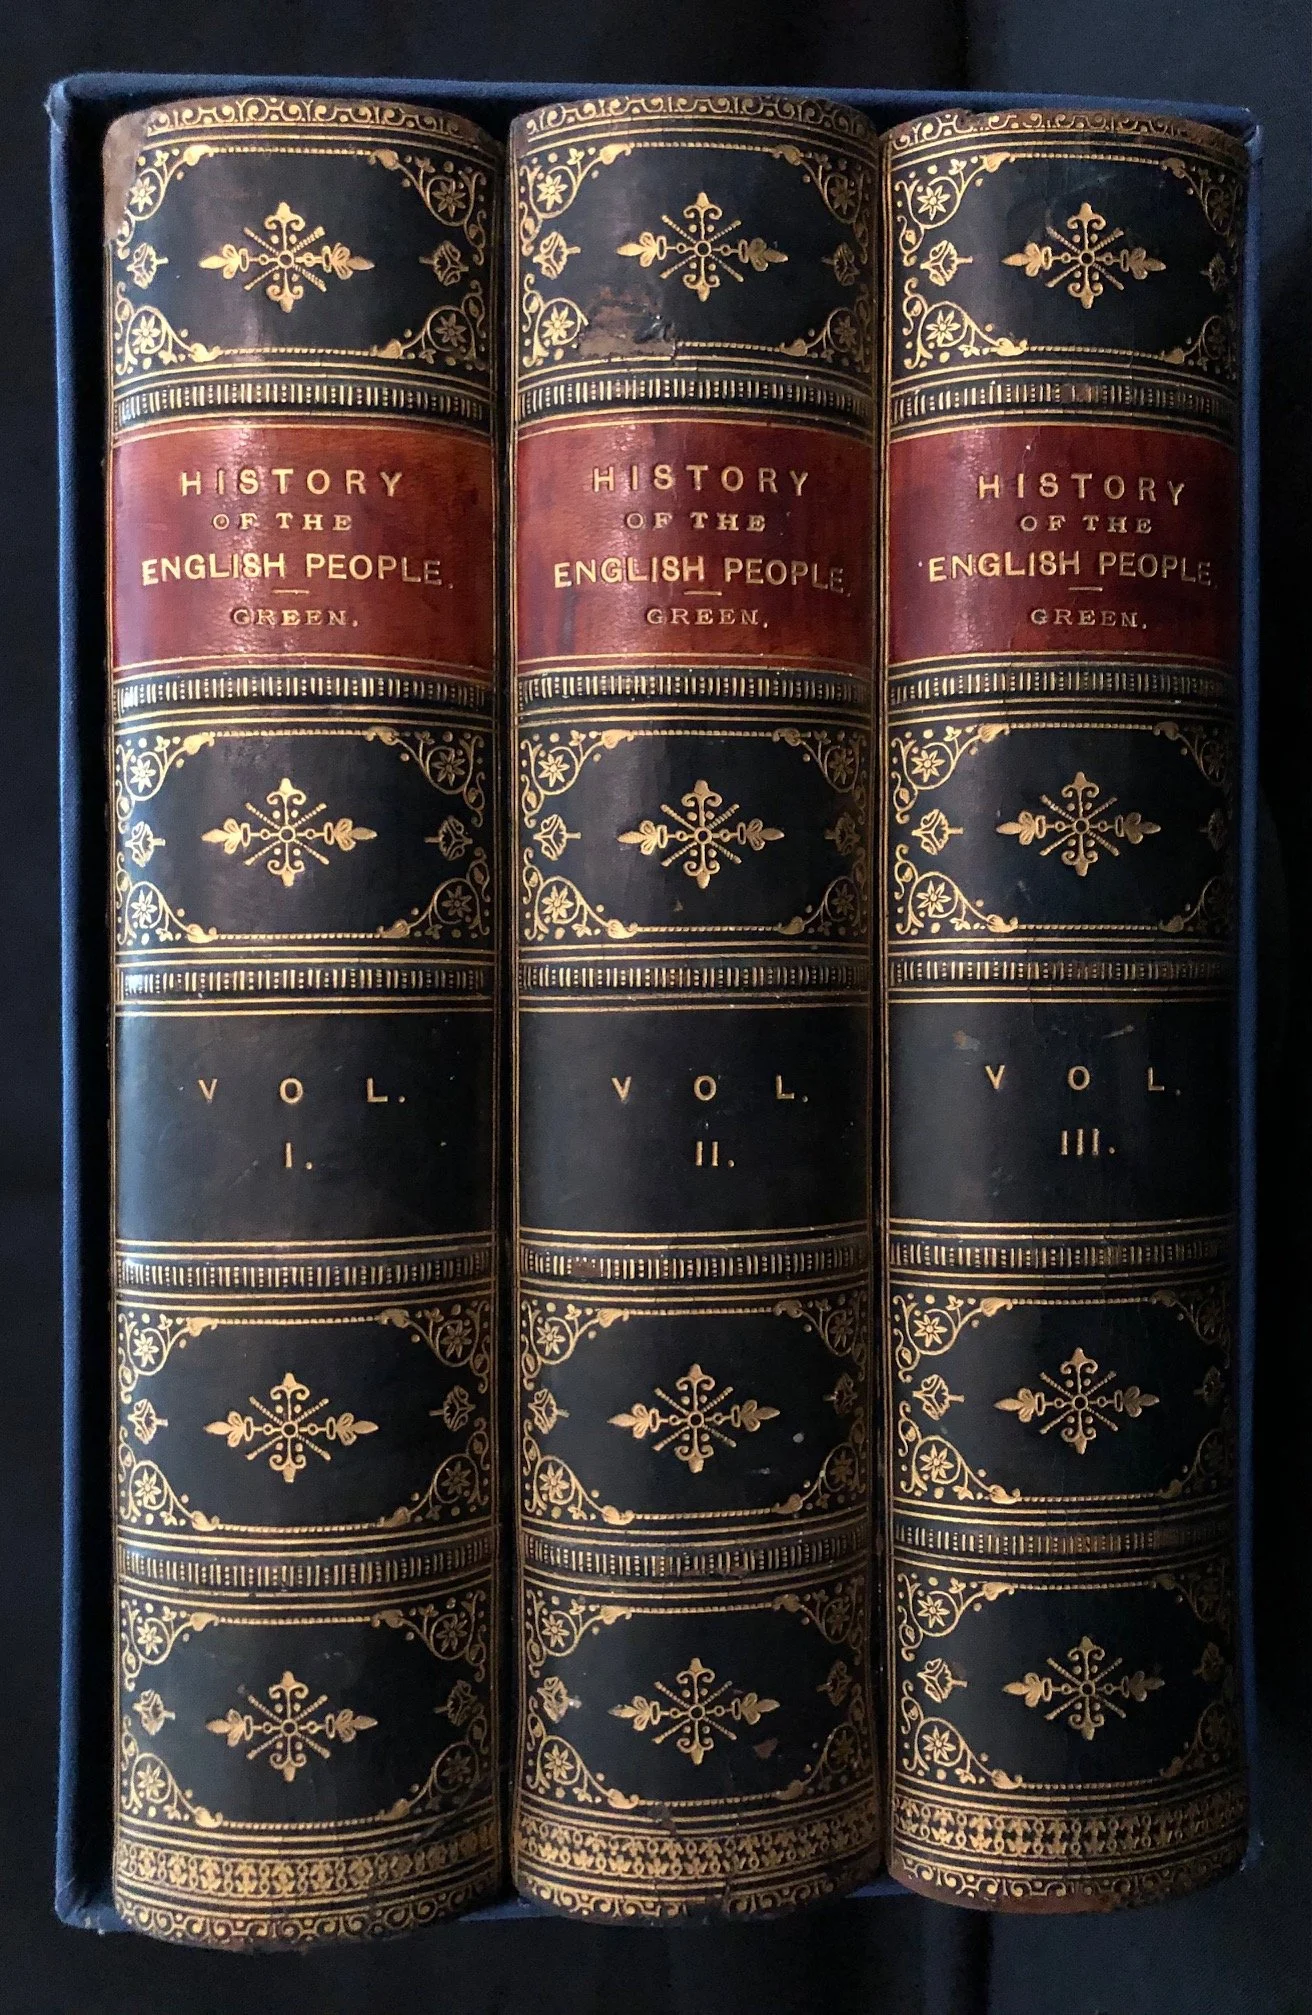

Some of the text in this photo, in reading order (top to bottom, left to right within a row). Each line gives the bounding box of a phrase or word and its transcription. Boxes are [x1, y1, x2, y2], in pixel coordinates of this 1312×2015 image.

[180, 468, 402, 497] HISTORY
[593, 464, 808, 496] HISTORY
[979, 472, 1184, 506] HISTORY
[212, 512, 352, 531] OF THE
[626, 512, 766, 532] OF THE
[1021, 515, 1152, 534] OF THE
[142, 553, 454, 589] ENGLISH PEOPLE.
[554, 556, 851, 598] ENGLISH PEOPLE.
[929, 550, 1218, 590] ENGLISH PEOPLE.
[233, 609, 358, 628] GREEN.
[647, 608, 768, 628] GREEN.
[1031, 608, 1147, 629] GREEN.
[695, 1141, 735, 1168] II.
[1060, 1128, 1116, 1155] III.
[285, 1142, 313, 1170] I.
